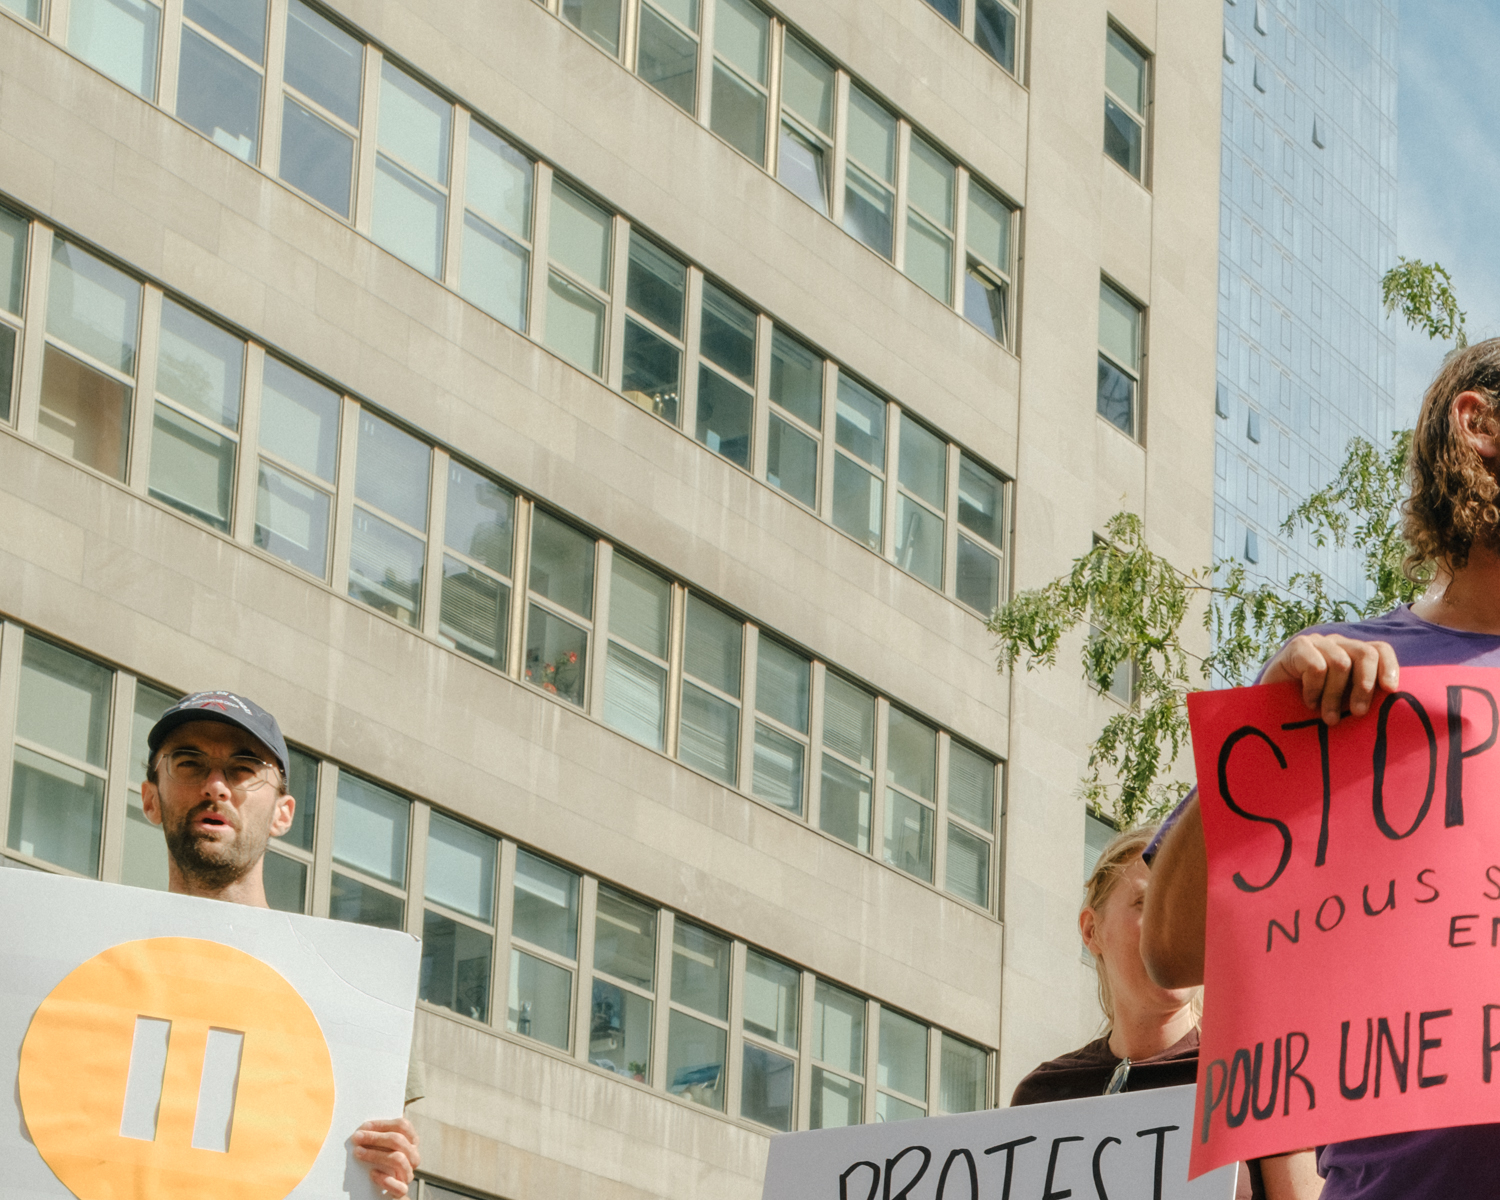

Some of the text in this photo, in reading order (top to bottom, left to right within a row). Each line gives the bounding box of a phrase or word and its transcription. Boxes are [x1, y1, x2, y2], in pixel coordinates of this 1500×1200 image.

[1266, 868, 1440, 953] NOUS
[1201, 1032, 1315, 1145] POUR
[1338, 1008, 1454, 1101] UNE
